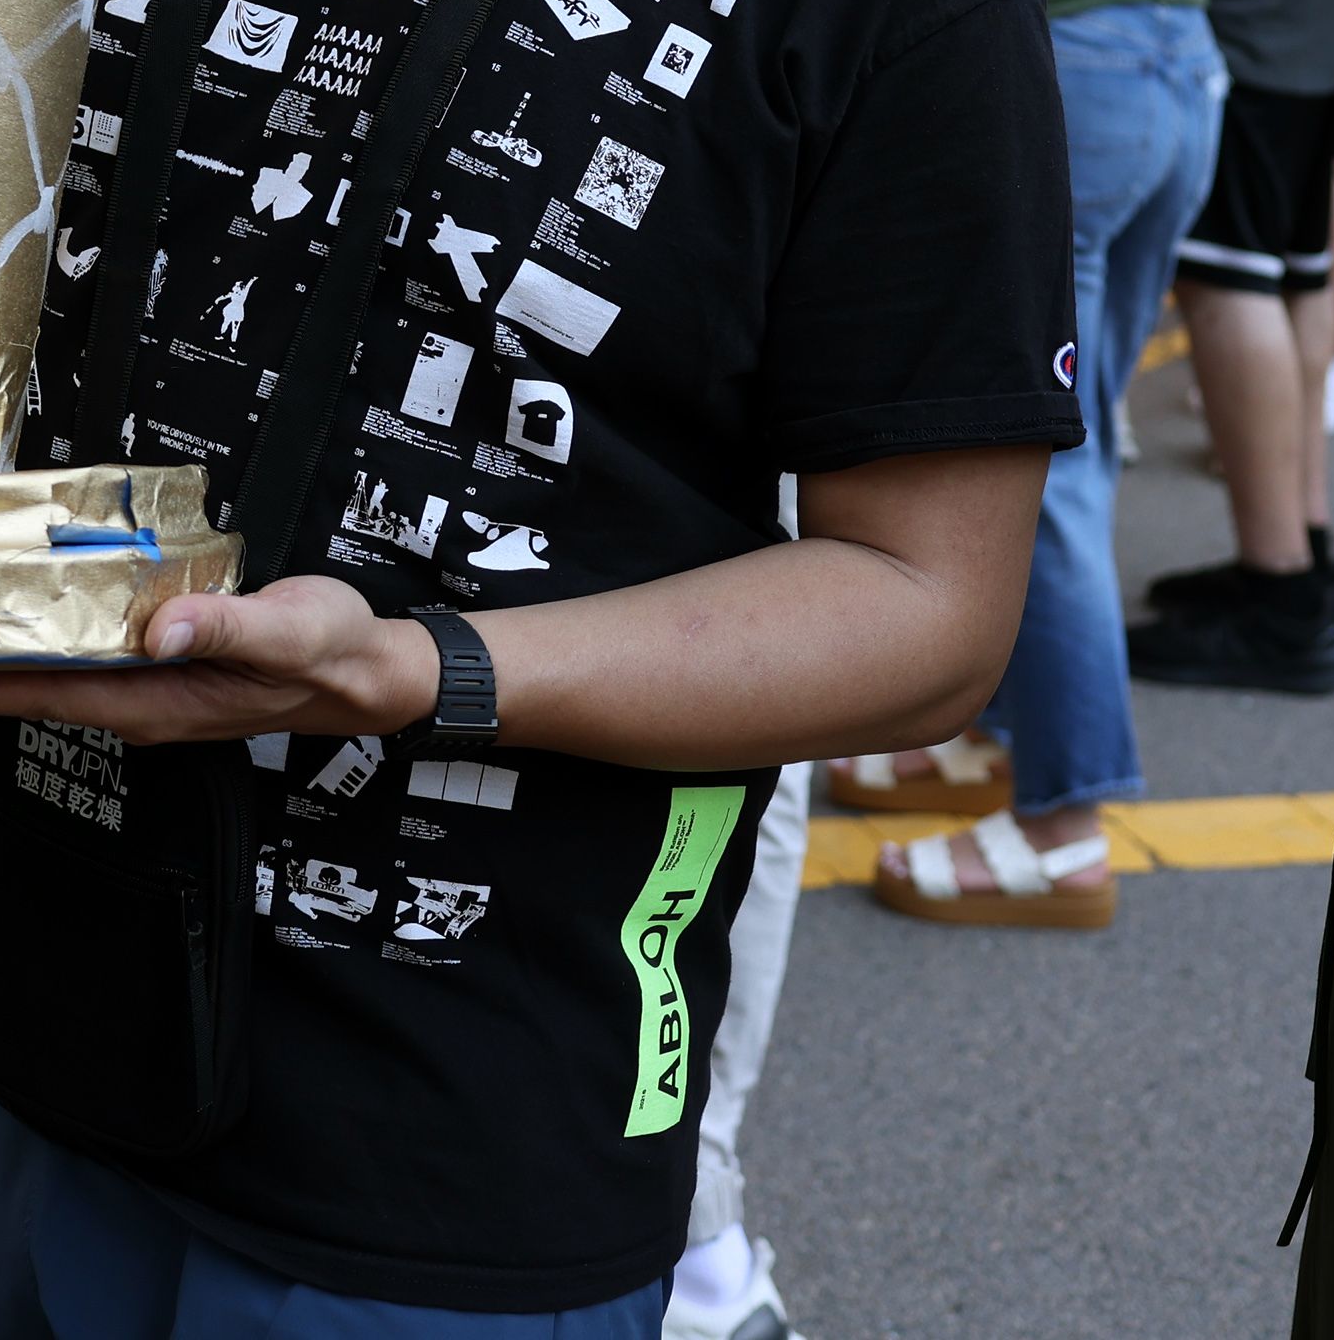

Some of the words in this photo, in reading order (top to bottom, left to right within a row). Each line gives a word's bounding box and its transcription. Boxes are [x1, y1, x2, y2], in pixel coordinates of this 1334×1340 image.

[147, 418, 170, 435] YOU'RE
[169, 427, 208, 448] OBVIOUSLY
[207, 440, 216, 451] IN
[215, 443, 232, 456] THE
[159, 435, 184, 451] WRONG
[15, 756, 123, 832] 極度乾燥
[639, 889, 696, 1100] ABLOH
